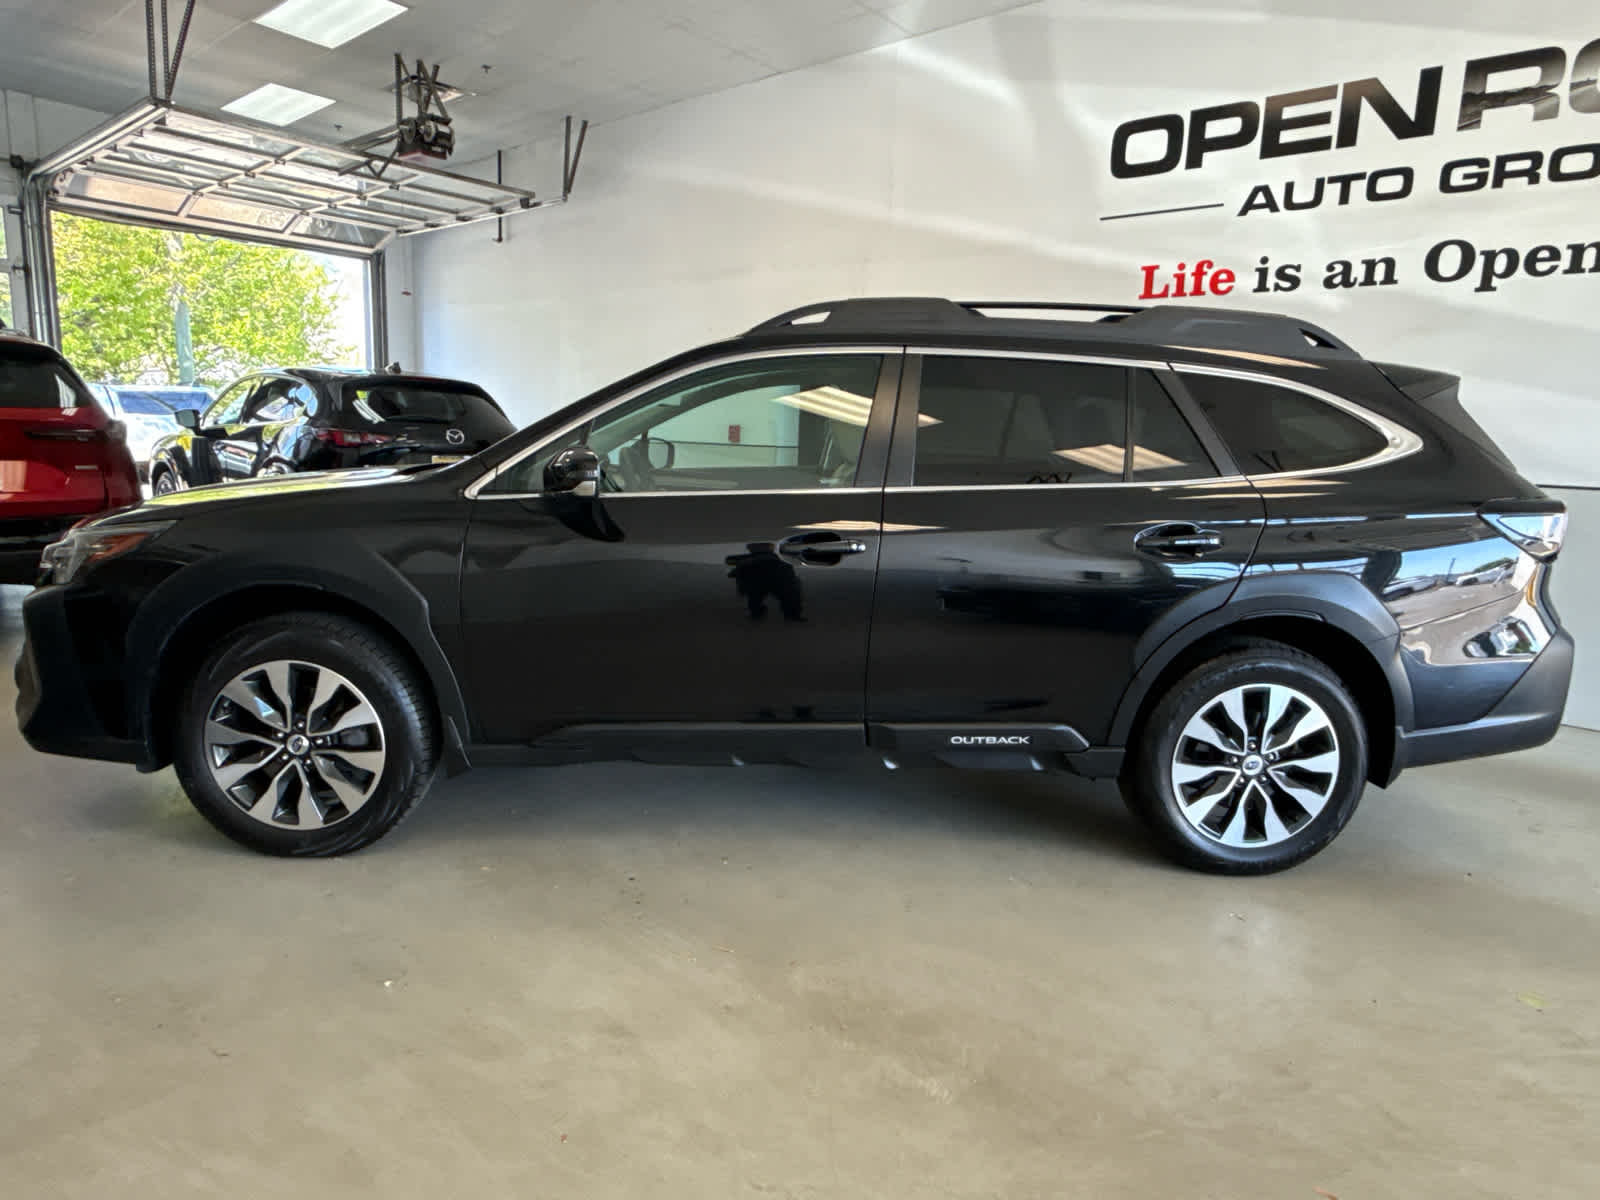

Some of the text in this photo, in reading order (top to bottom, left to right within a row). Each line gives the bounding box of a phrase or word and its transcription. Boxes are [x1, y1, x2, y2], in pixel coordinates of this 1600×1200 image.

[1110, 65, 1443, 179] OPEN
[1237, 166, 1414, 217] AUTO
[1138, 239, 1600, 300] Life is an Open
[950, 735, 1030, 745] OUTBACK
